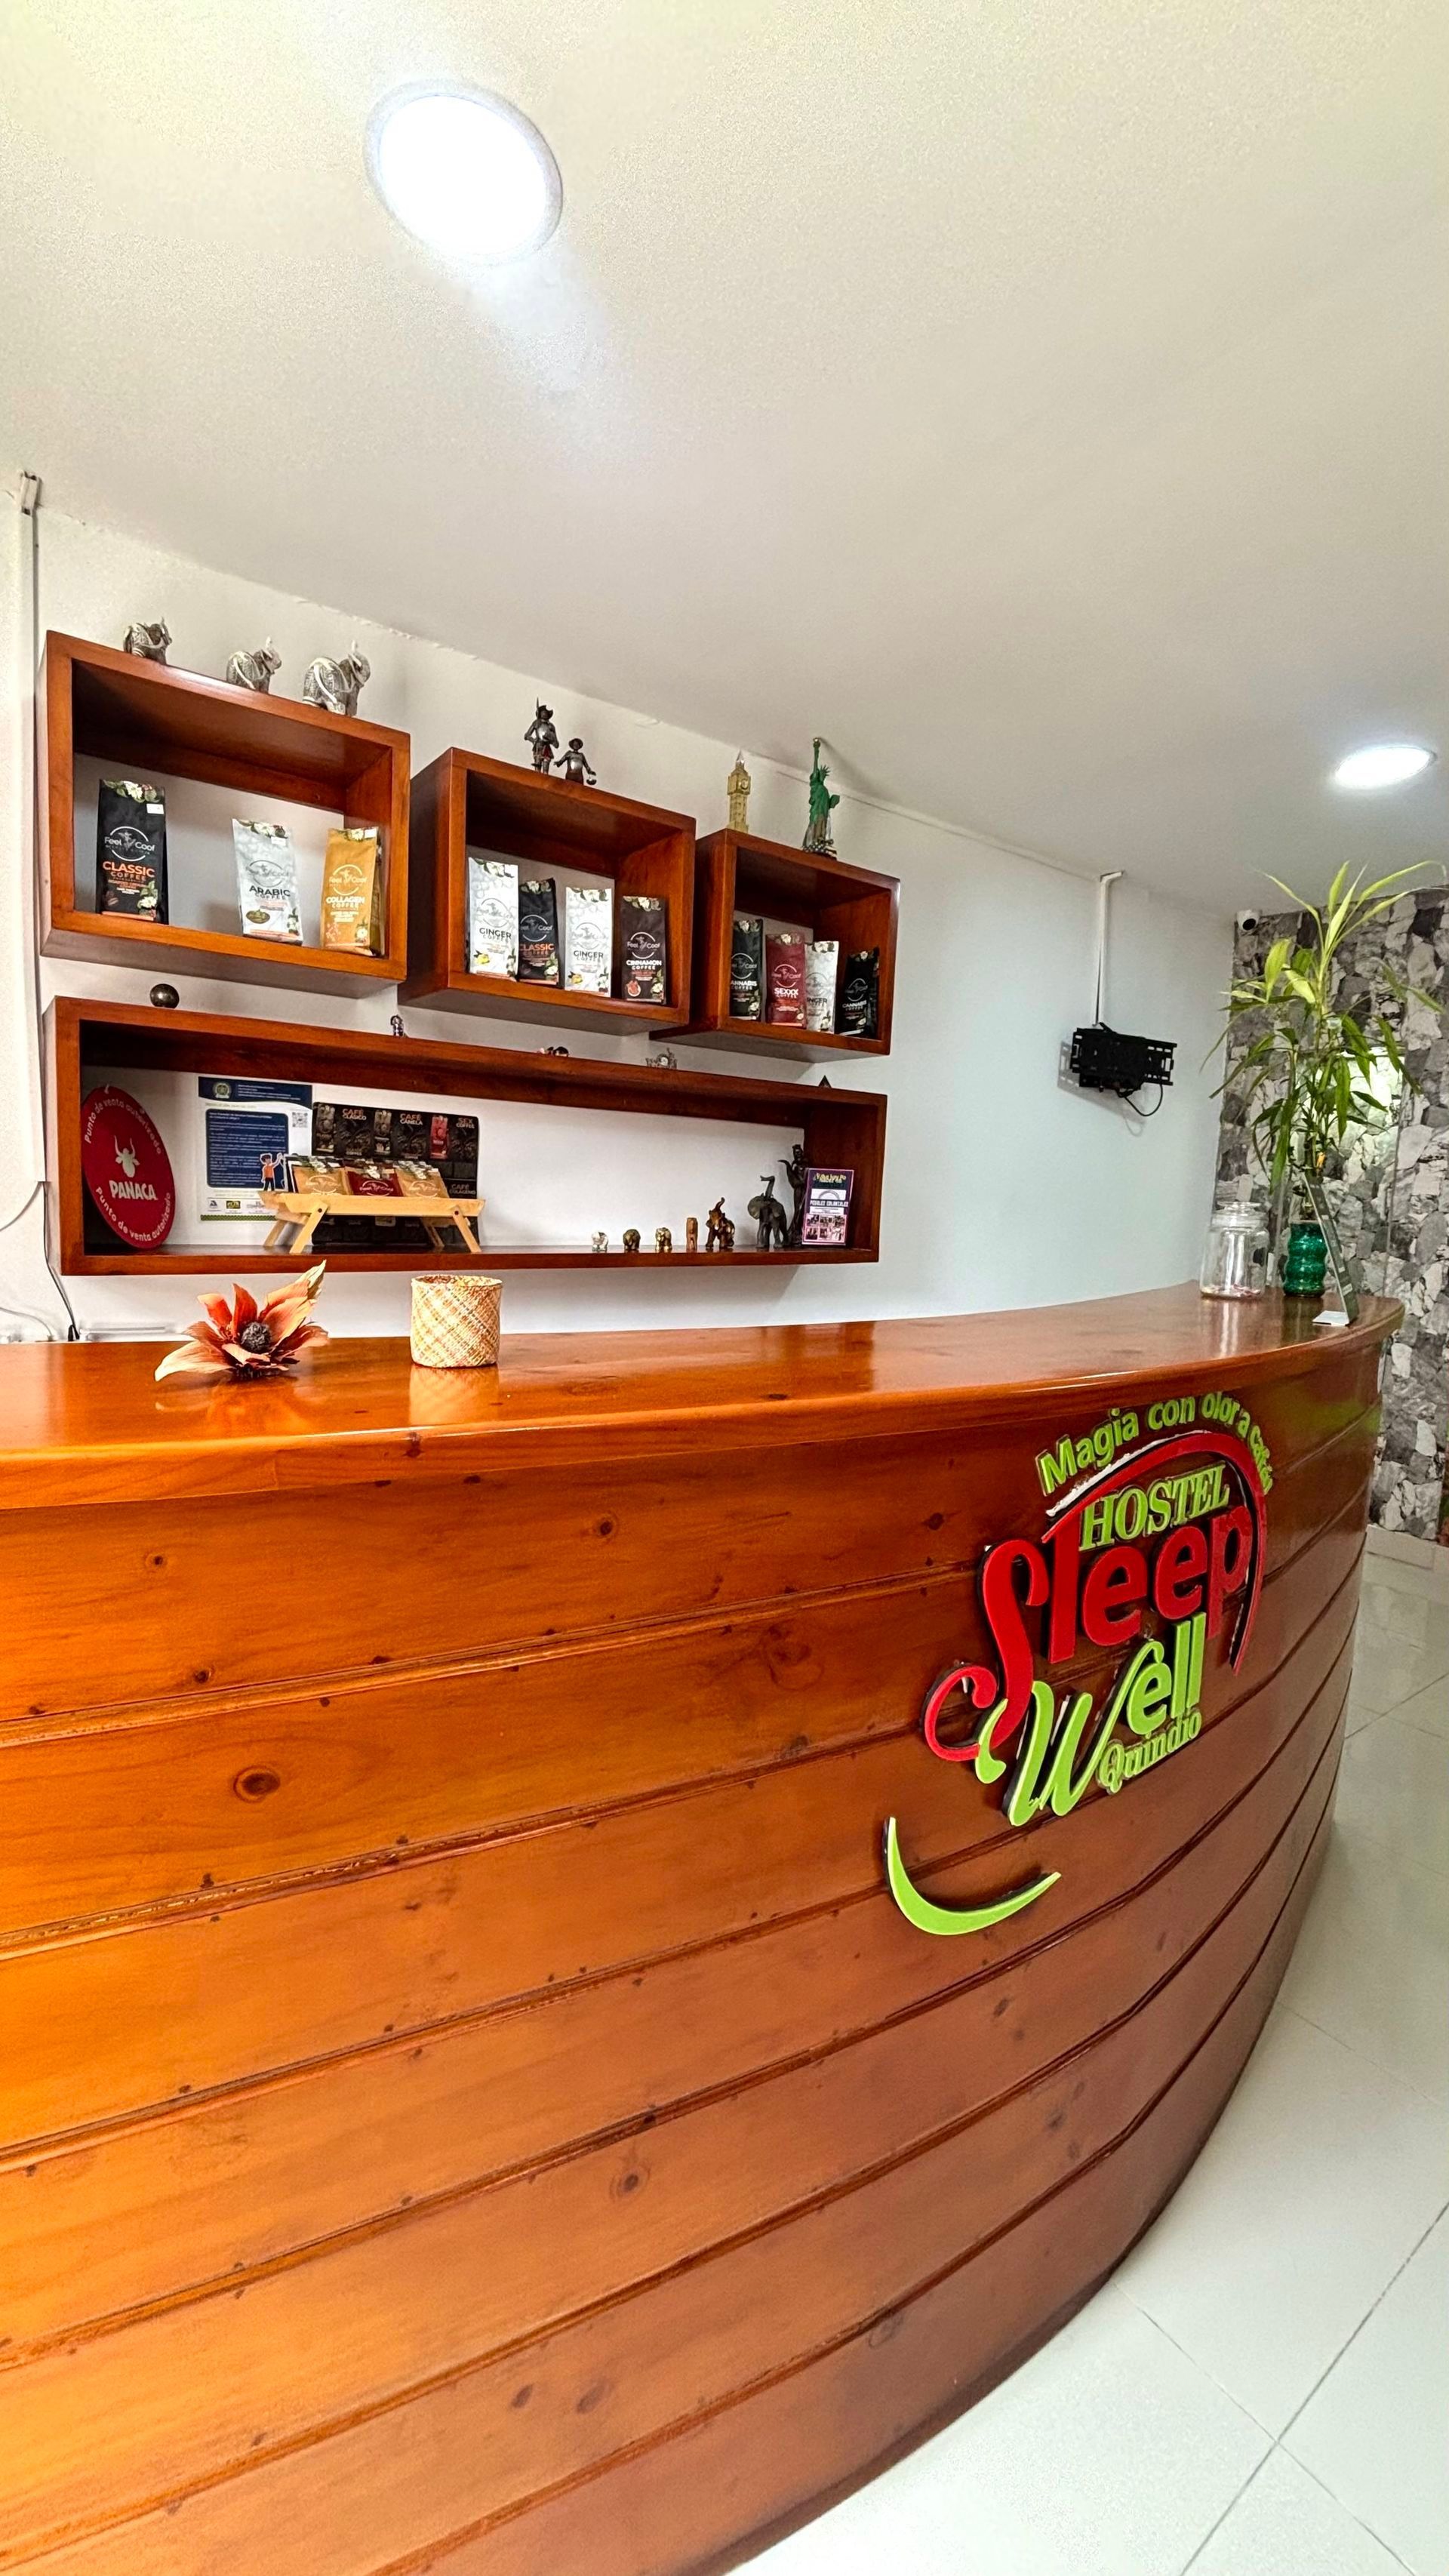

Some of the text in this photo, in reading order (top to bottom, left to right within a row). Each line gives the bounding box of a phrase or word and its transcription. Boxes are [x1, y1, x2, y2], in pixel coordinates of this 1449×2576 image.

[104, 836, 122, 846] Feel
[102, 861, 155, 878] CLASSIC
[110, 871, 146, 882] COFFEE
[249, 885, 291, 897] ARABIC
[326, 896, 365, 904] COLLAGEN
[479, 928, 512, 940] GINGER
[574, 950, 604, 959] GINGER
[774, 987, 799, 996] SEXXX
[85, 1112, 97, 1144] Punto
[94, 1102, 104, 1114] de
[103, 1098, 125, 1108] venta
[109, 1180, 158, 1201] PANACA
[95, 1186, 171, 1242] Punto de venta autorizado
[1039, 1408, 1139, 1494] Magia
[1147, 1396, 1196, 1430] con
[1201, 1392, 1240, 1426] olor
[1237, 1411, 1251, 1438] a
[1077, 1463, 1231, 1552] HOSTEL
[924, 1506, 1254, 1762] Sleep
[975, 1611, 1207, 1827] Well
